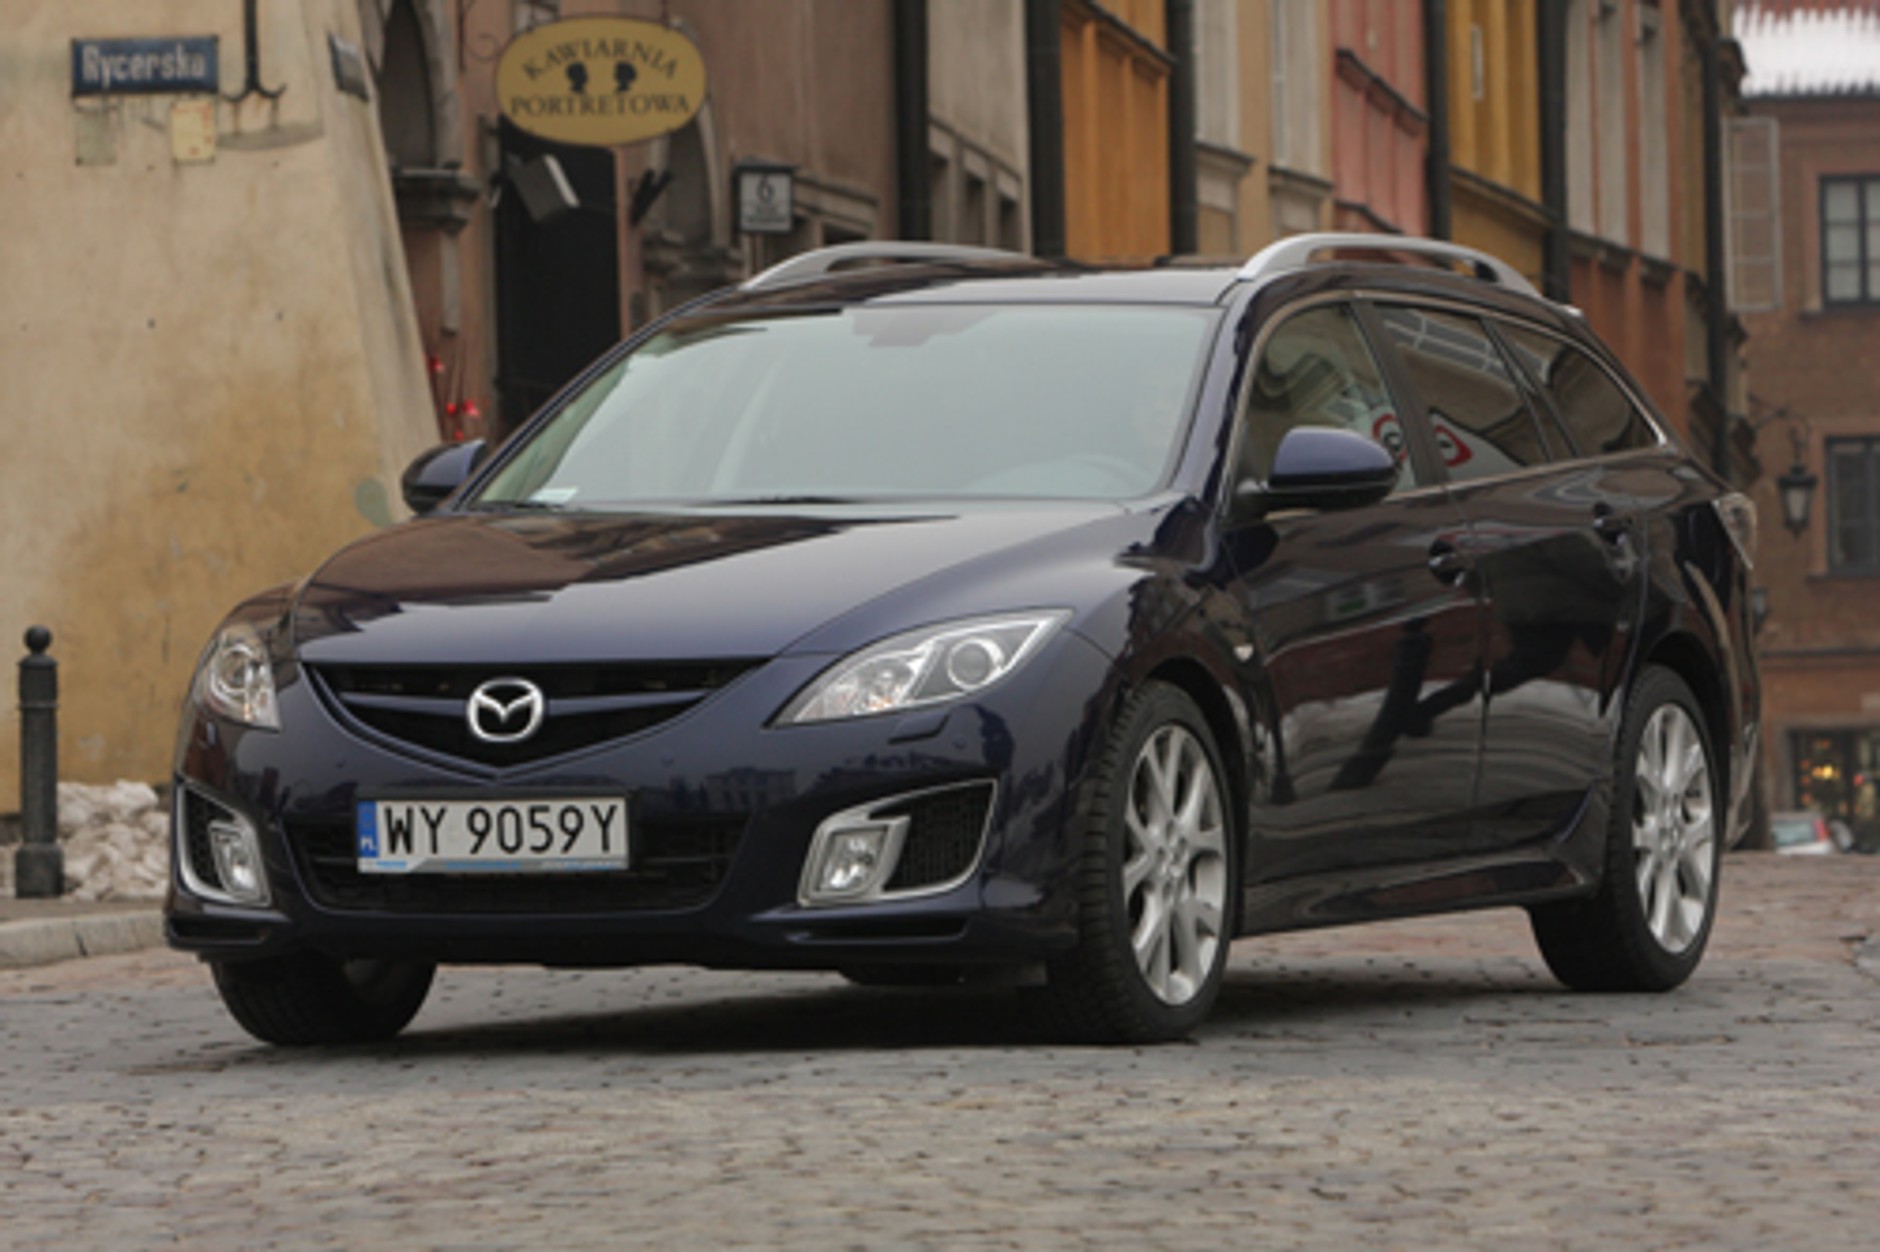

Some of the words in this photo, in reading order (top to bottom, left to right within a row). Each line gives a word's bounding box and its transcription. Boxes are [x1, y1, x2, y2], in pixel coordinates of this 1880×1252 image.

[81, 43, 206, 88] Rycerska
[522, 37, 678, 80] KAWIARNIA
[511, 94, 690, 116] PORTRETOWA
[756, 174, 776, 204] 6
[360, 835, 376, 850] PL
[384, 804, 447, 854] WY
[466, 804, 618, 854] 9059Y
